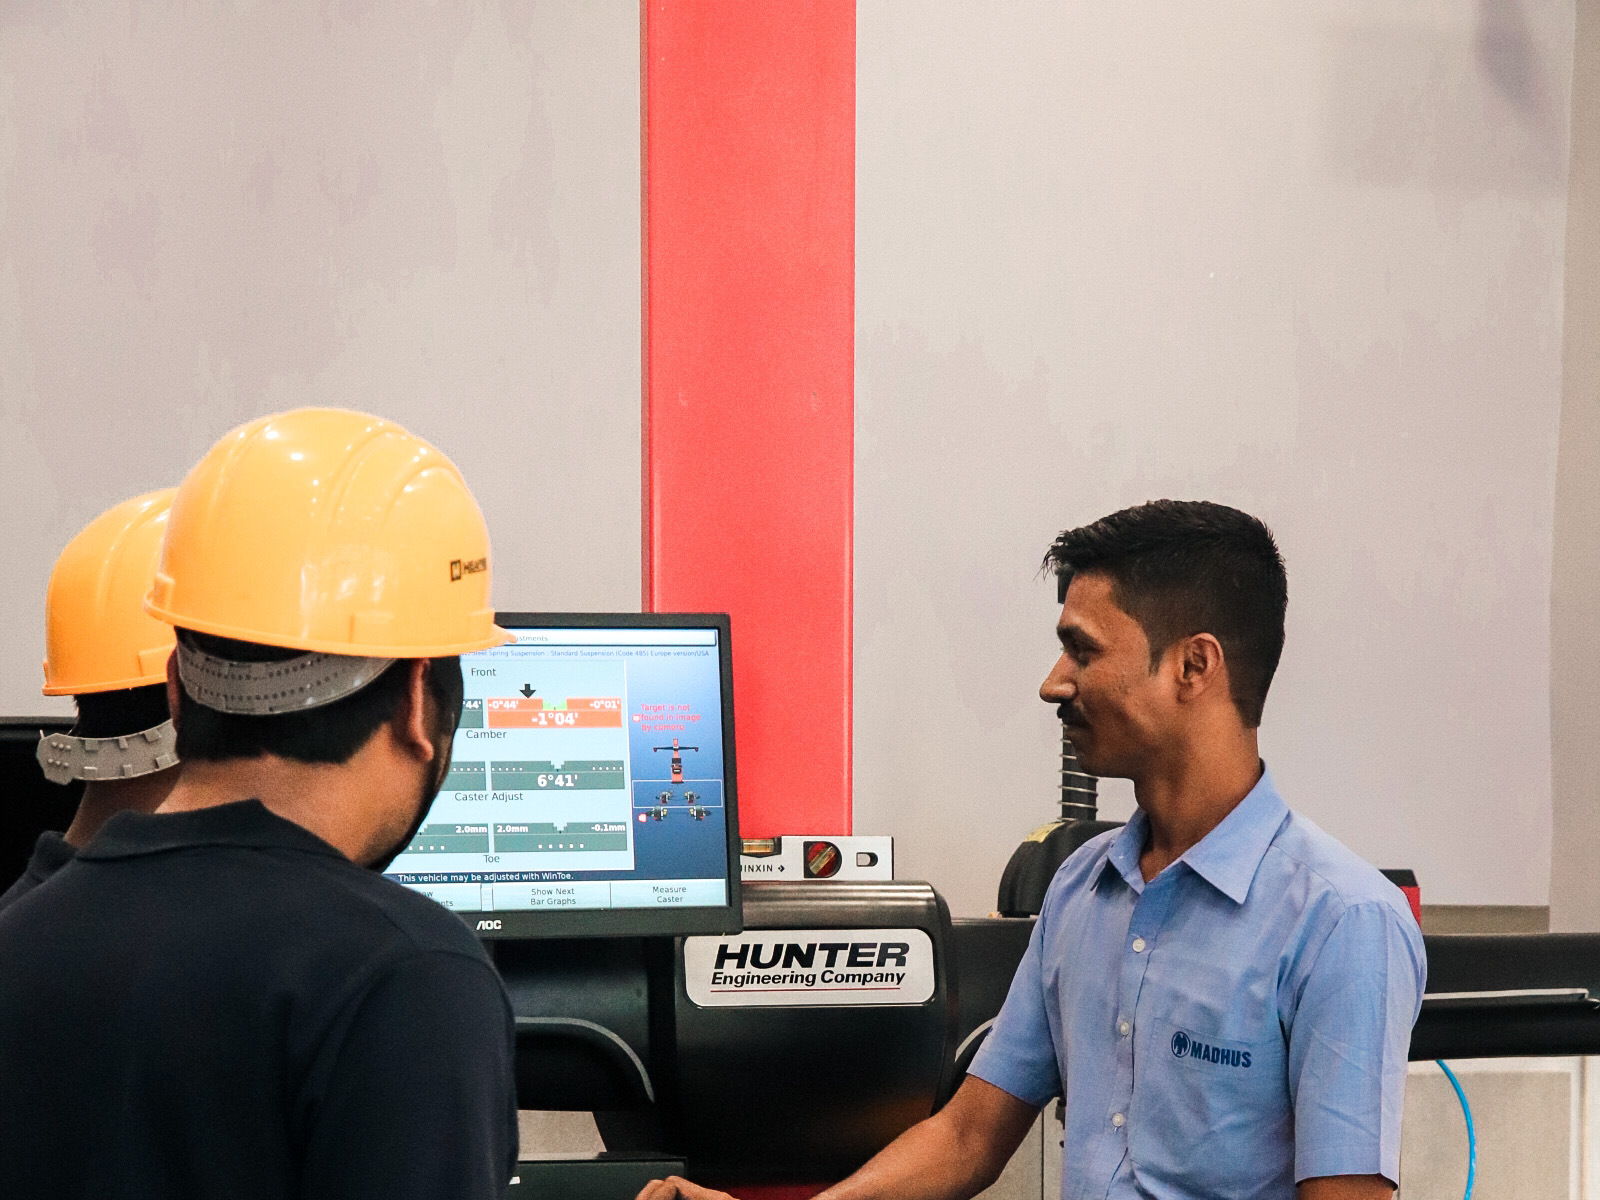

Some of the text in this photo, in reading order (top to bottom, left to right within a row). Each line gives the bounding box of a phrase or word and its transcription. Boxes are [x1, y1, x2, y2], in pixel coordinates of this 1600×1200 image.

[489, 650, 509, 658] Spring
[510, 650, 545, 658] Suspension
[579, 650, 614, 658] Suspension
[650, 650, 672, 658] Europe
[470, 667, 497, 677] Front
[641, 703, 691, 713] Target is not
[531, 711, 579, 726] -1°04'
[640, 713, 702, 723] found in image
[641, 723, 652, 733] by
[465, 729, 507, 739] Camber
[537, 774, 578, 787] 6°41'
[454, 791, 524, 802] Caster Adjust
[455, 825, 488, 834] 2.0mm
[496, 824, 529, 833] 2.0mm
[590, 823, 626, 832] -0.1mm
[483, 854, 501, 863] Toe
[741, 864, 773, 873] INXIN
[397, 871, 574, 883] This vehicle may be adjusted with WinToe.
[531, 887, 575, 896] Show Next
[652, 886, 687, 894] Measure
[530, 897, 577, 907] Bar Graphs
[656, 895, 684, 903] Caster
[476, 919, 502, 931] AOC
[714, 942, 910, 969] HUNTER
[711, 969, 906, 988] Engineering Company
[1190, 1041, 1252, 1068] MADHUS
